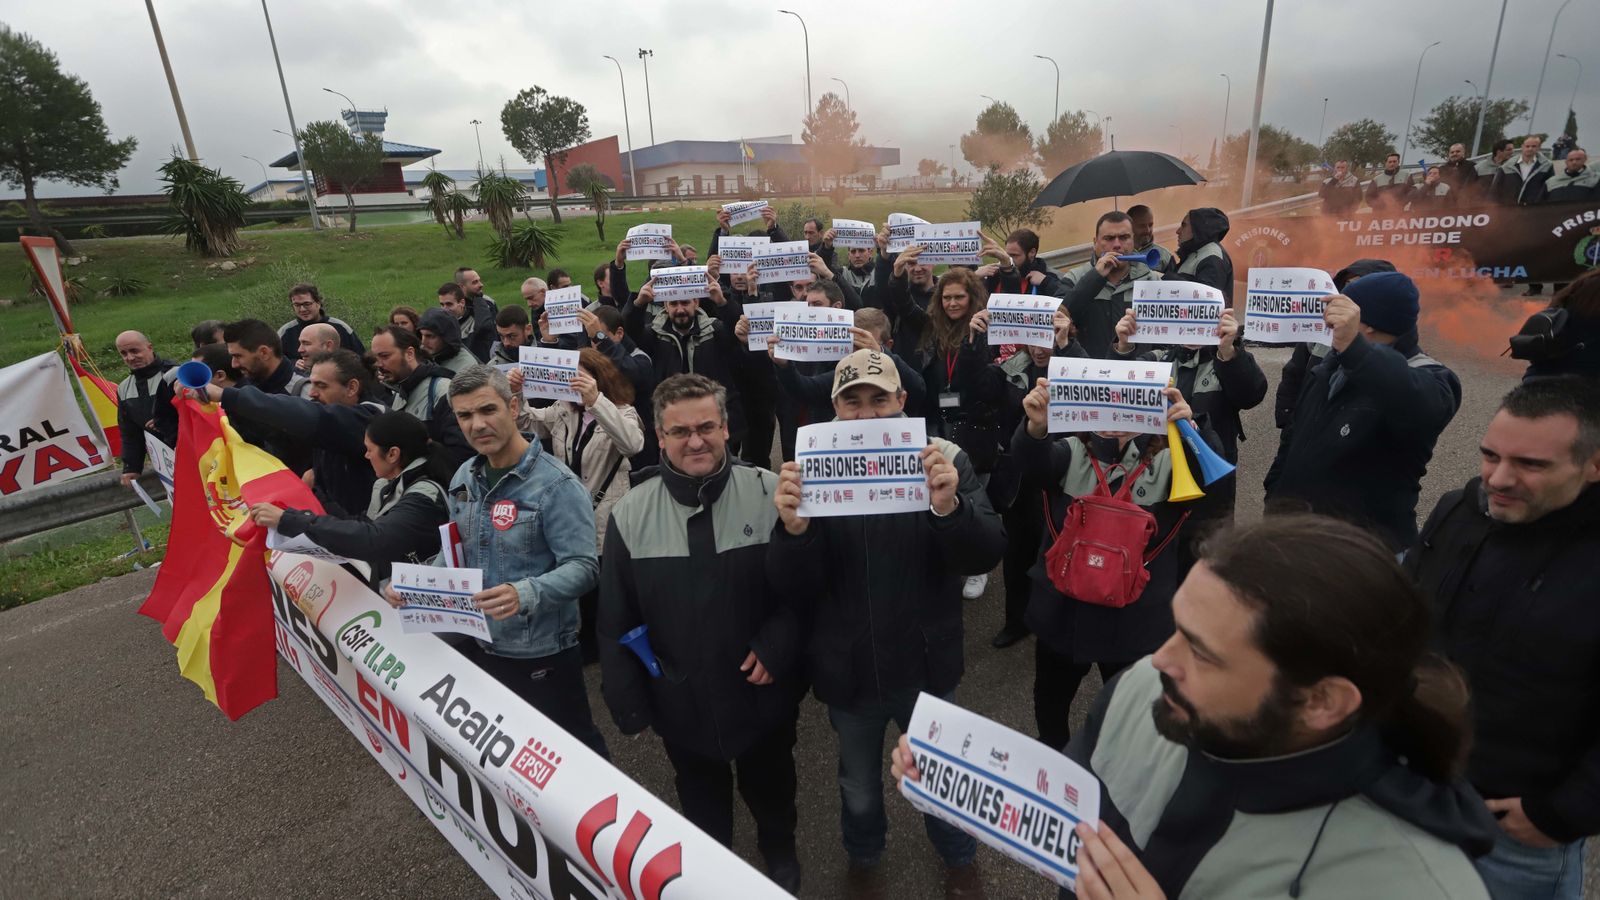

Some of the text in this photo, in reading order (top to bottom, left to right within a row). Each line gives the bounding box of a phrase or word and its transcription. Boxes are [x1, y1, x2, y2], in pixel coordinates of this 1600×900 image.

[1337, 213, 1490, 233] TU ABANDONO
[1235, 227, 1291, 247] PRISIONES
[1356, 231, 1462, 246] ME PUEDE
[1449, 265, 1528, 279] LUCHA
[494, 503, 514, 516] UGT
[341, 624, 375, 653] CSIF
[419, 673, 515, 769] Acaip
[515, 748, 551, 785] EPSU
